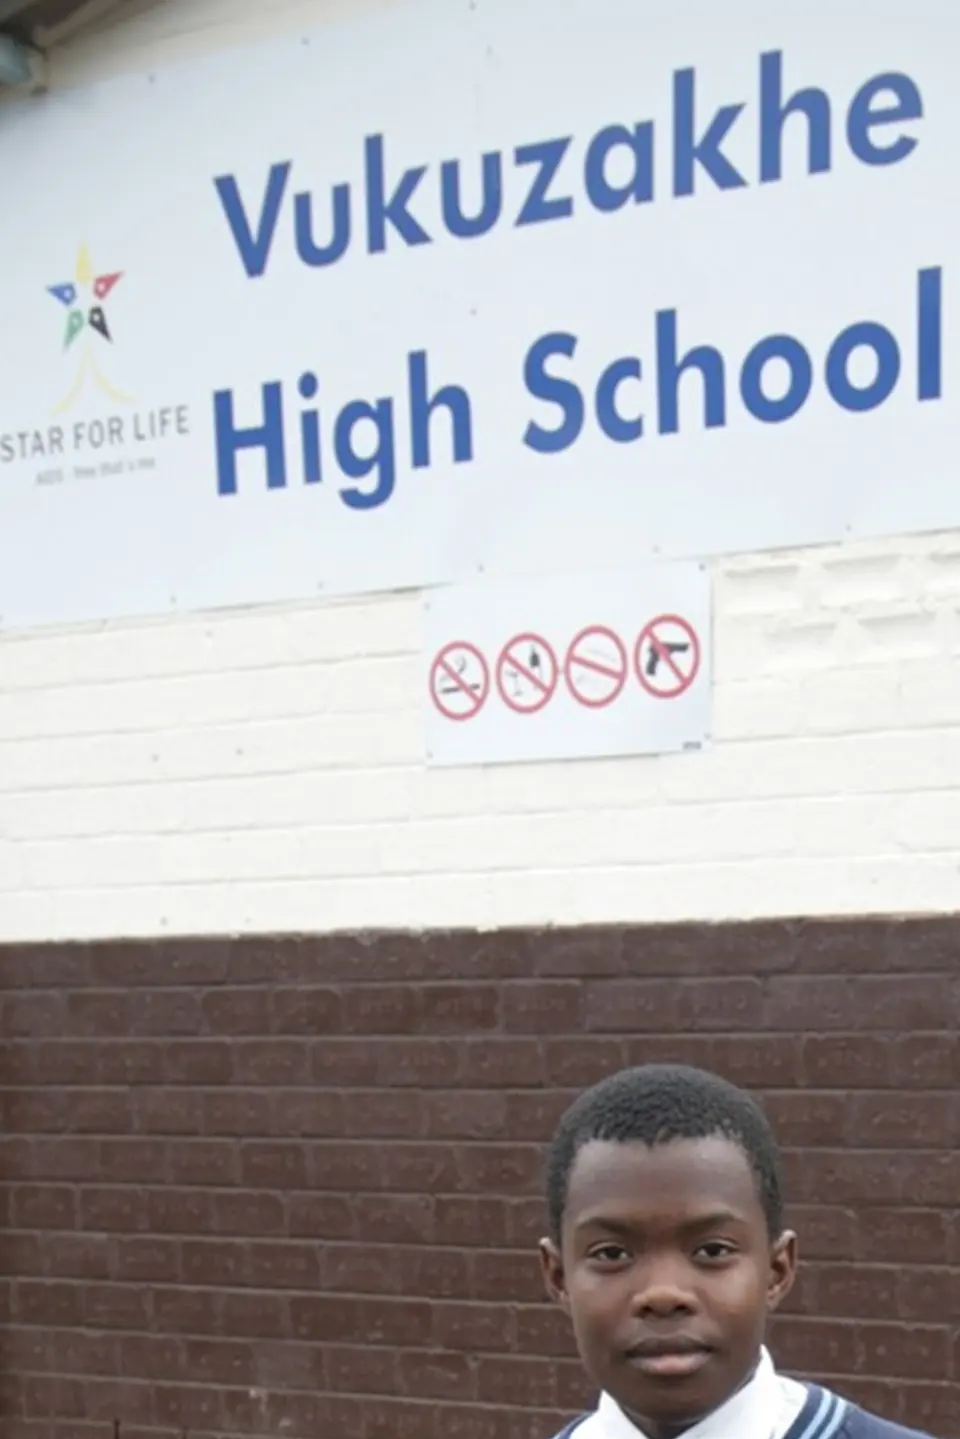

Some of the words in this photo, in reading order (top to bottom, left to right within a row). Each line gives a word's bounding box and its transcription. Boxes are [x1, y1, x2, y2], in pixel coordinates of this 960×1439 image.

[213, 49, 924, 279] Vukuzakhe
[0, 425, 64, 464] STAR
[73, 416, 124, 450] FOR
[133, 404, 190, 442] LIFE
[212, 349, 474, 511] High
[522, 265, 943, 455] School
